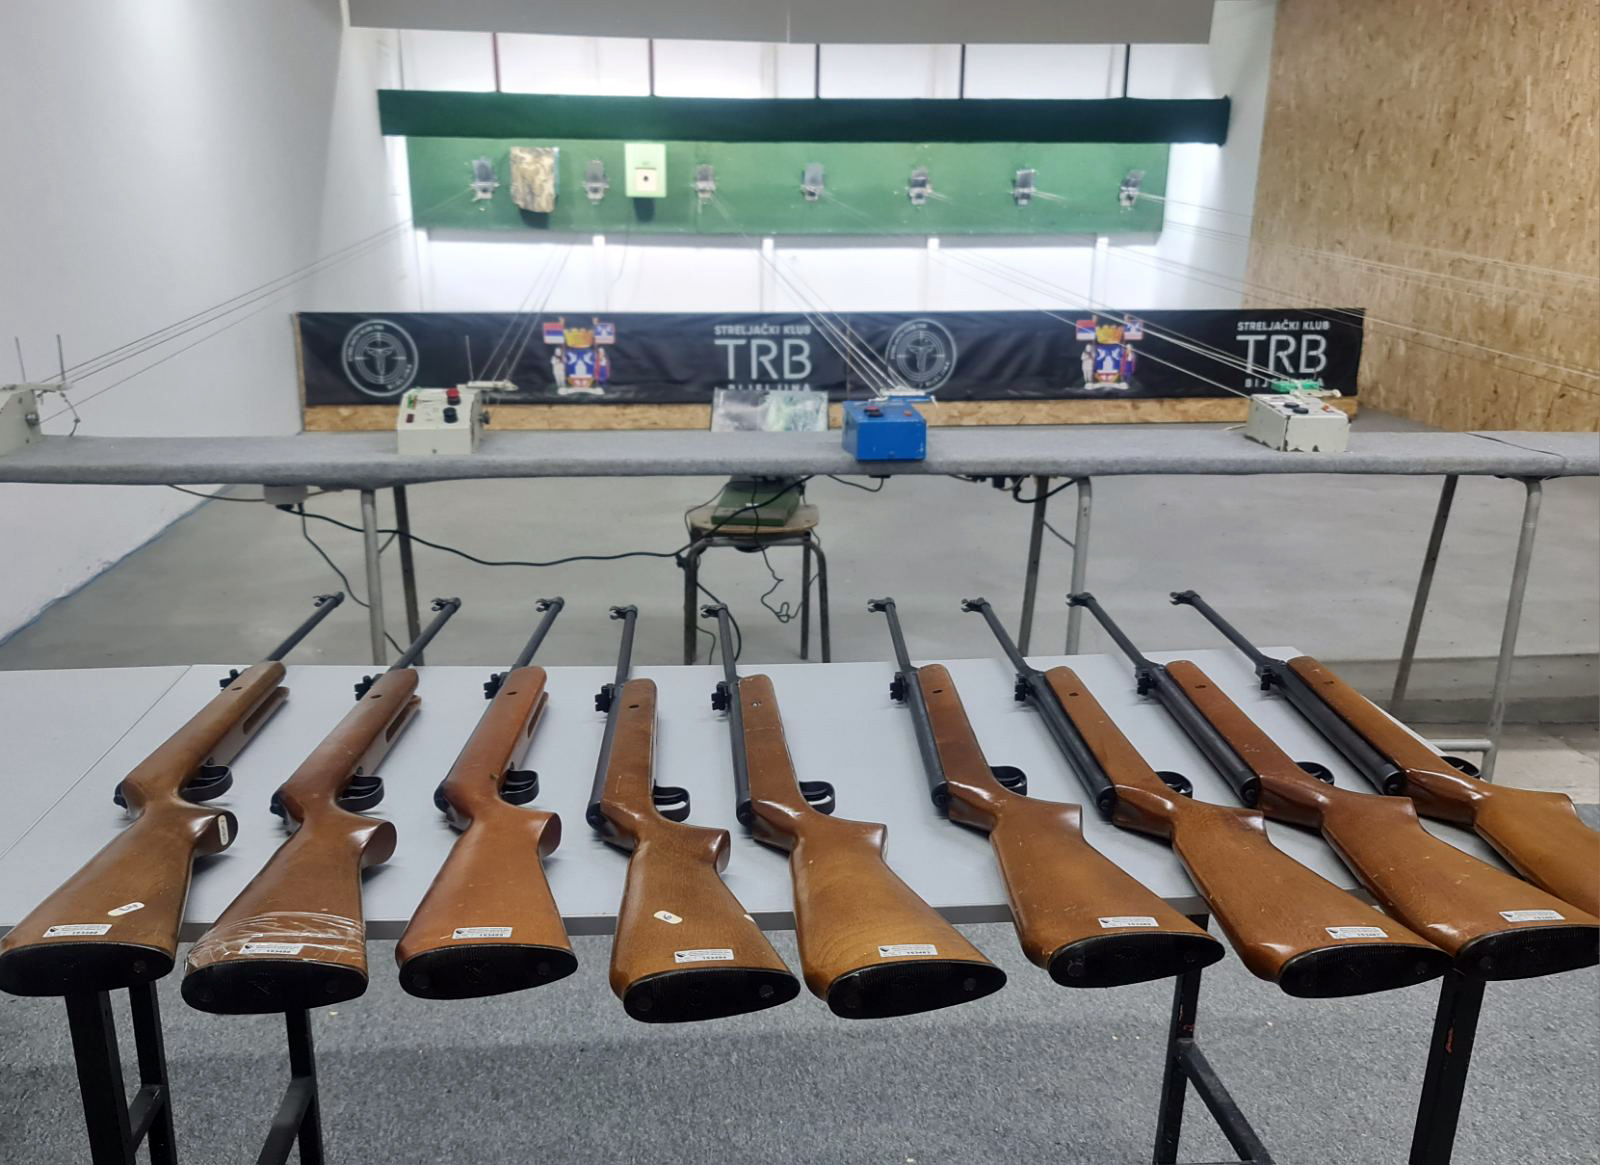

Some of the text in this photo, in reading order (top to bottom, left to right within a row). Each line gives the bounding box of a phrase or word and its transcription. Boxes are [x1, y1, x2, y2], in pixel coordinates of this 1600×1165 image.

[714, 323, 811, 335] STRELJAČKI KLUB
[1237, 318, 1331, 331] STRELJAČKI KLUB
[714, 339, 812, 380] TRB
[1236, 334, 1327, 373] TRB
